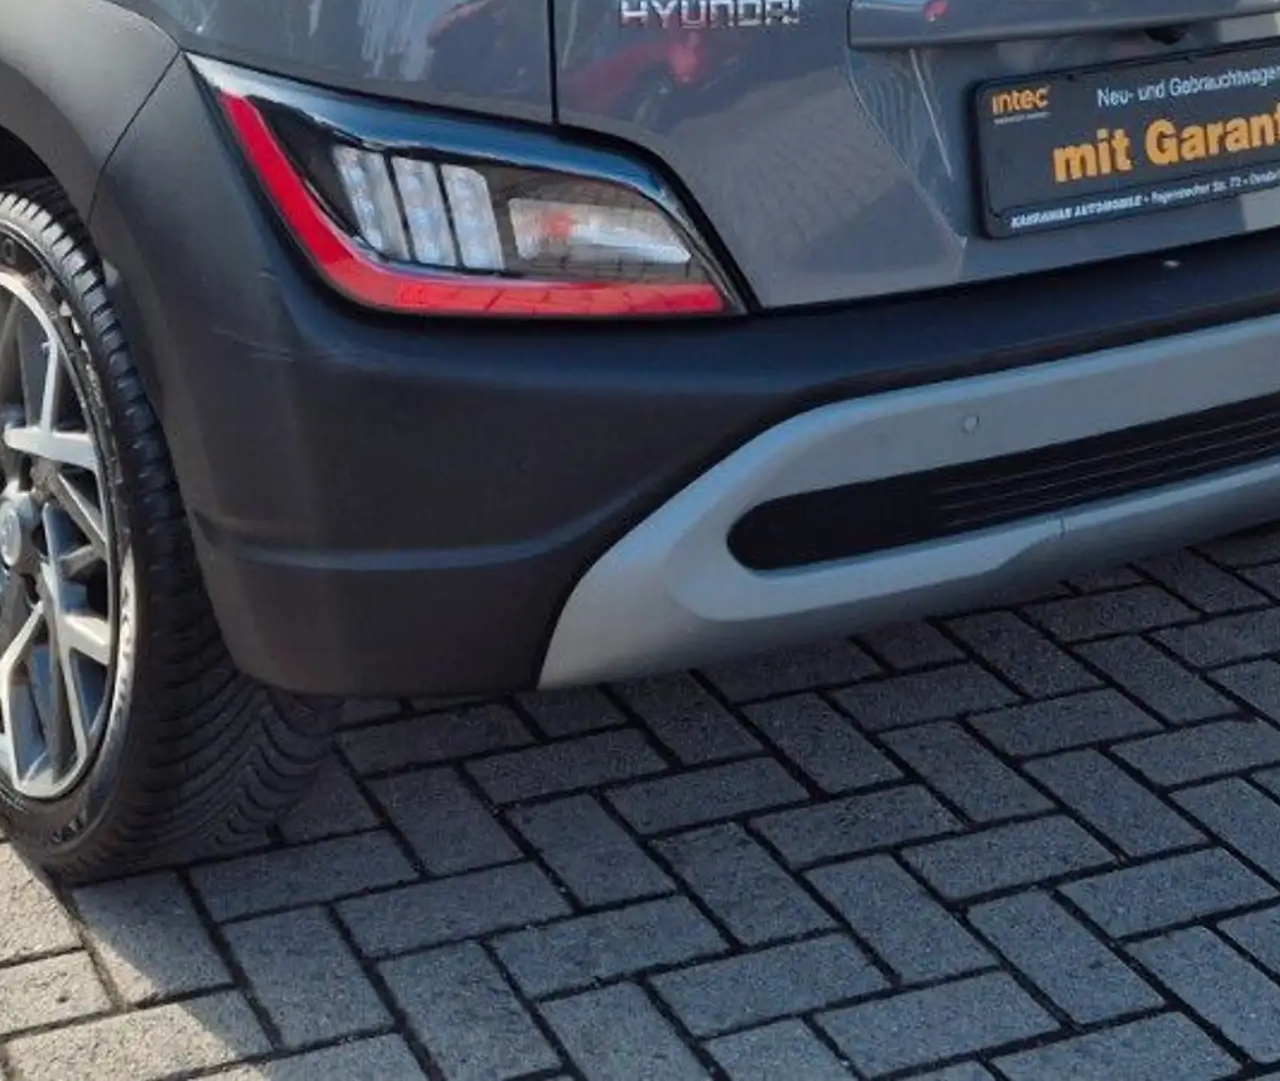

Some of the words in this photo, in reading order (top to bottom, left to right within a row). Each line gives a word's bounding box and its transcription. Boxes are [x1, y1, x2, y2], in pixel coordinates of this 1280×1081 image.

[1096, 87, 1133, 108] Neu-
[1137, 79, 1165, 101] und
[1053, 128, 1132, 183] mit
